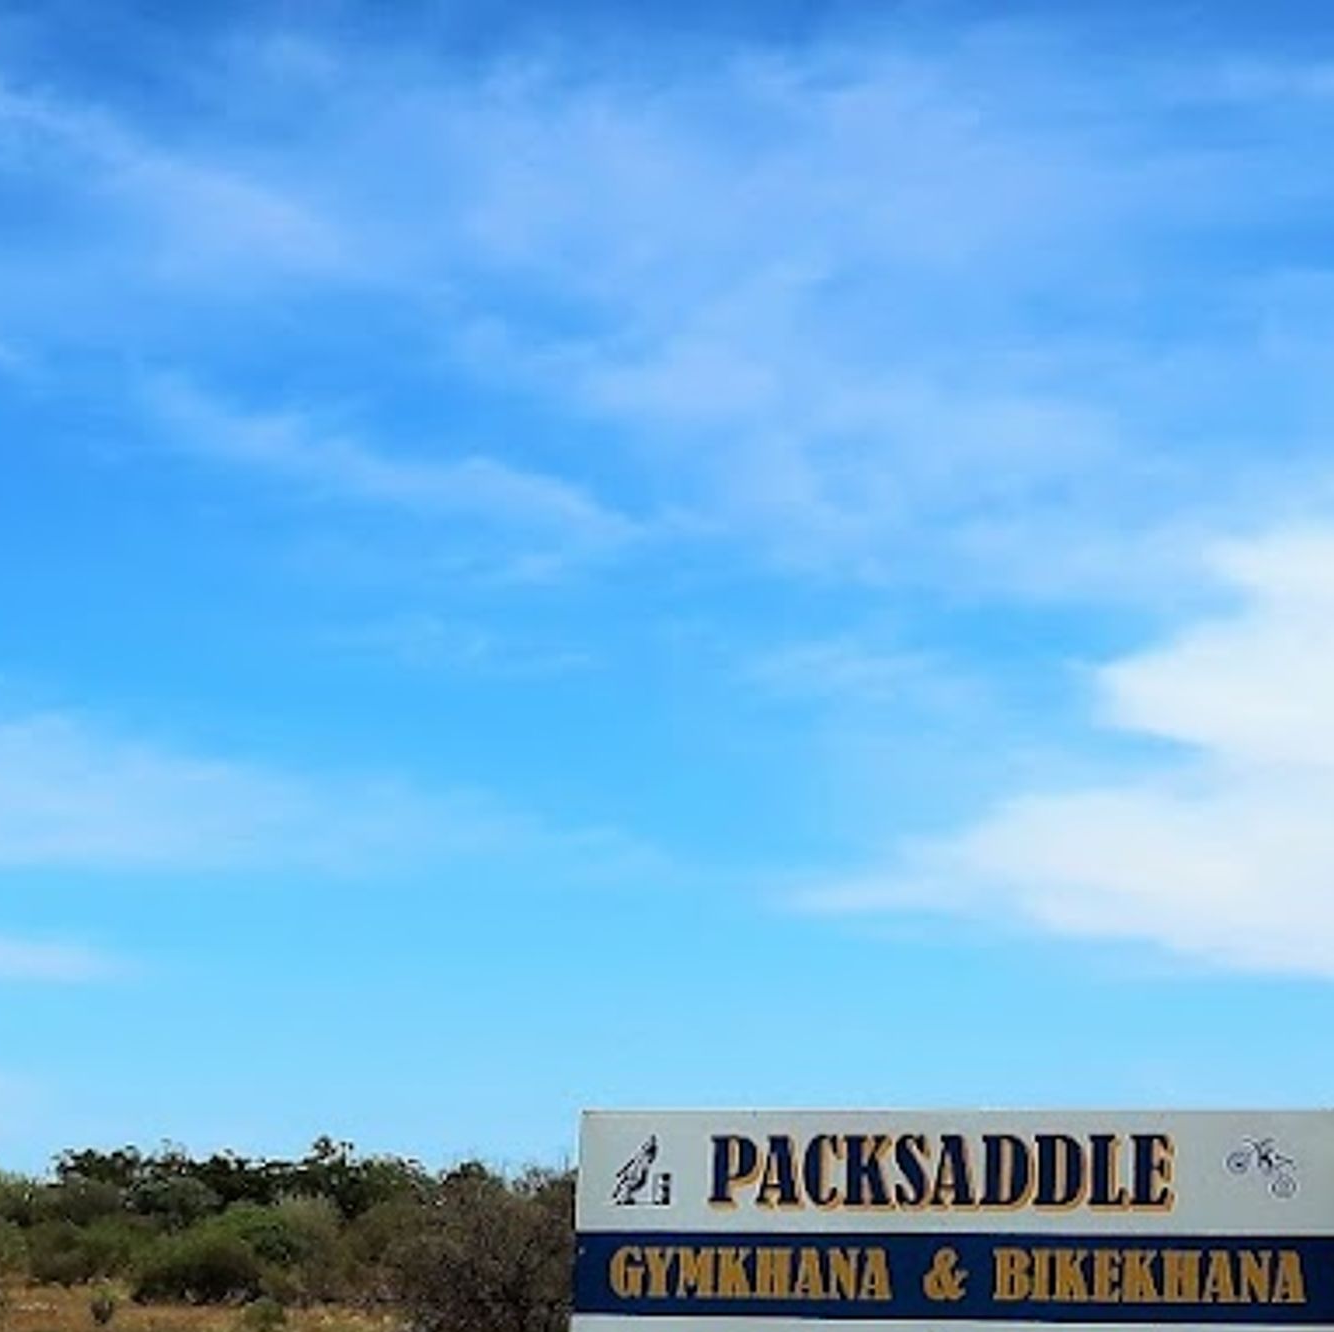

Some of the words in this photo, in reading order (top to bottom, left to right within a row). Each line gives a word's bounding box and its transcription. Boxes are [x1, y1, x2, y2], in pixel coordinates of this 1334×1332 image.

[708, 1132, 1177, 1212] PACKSADDLE
[610, 1246, 891, 1301] GYMKHANA
[923, 1248, 966, 1300] &
[993, 1247, 1307, 1305] BIKEKHANA
